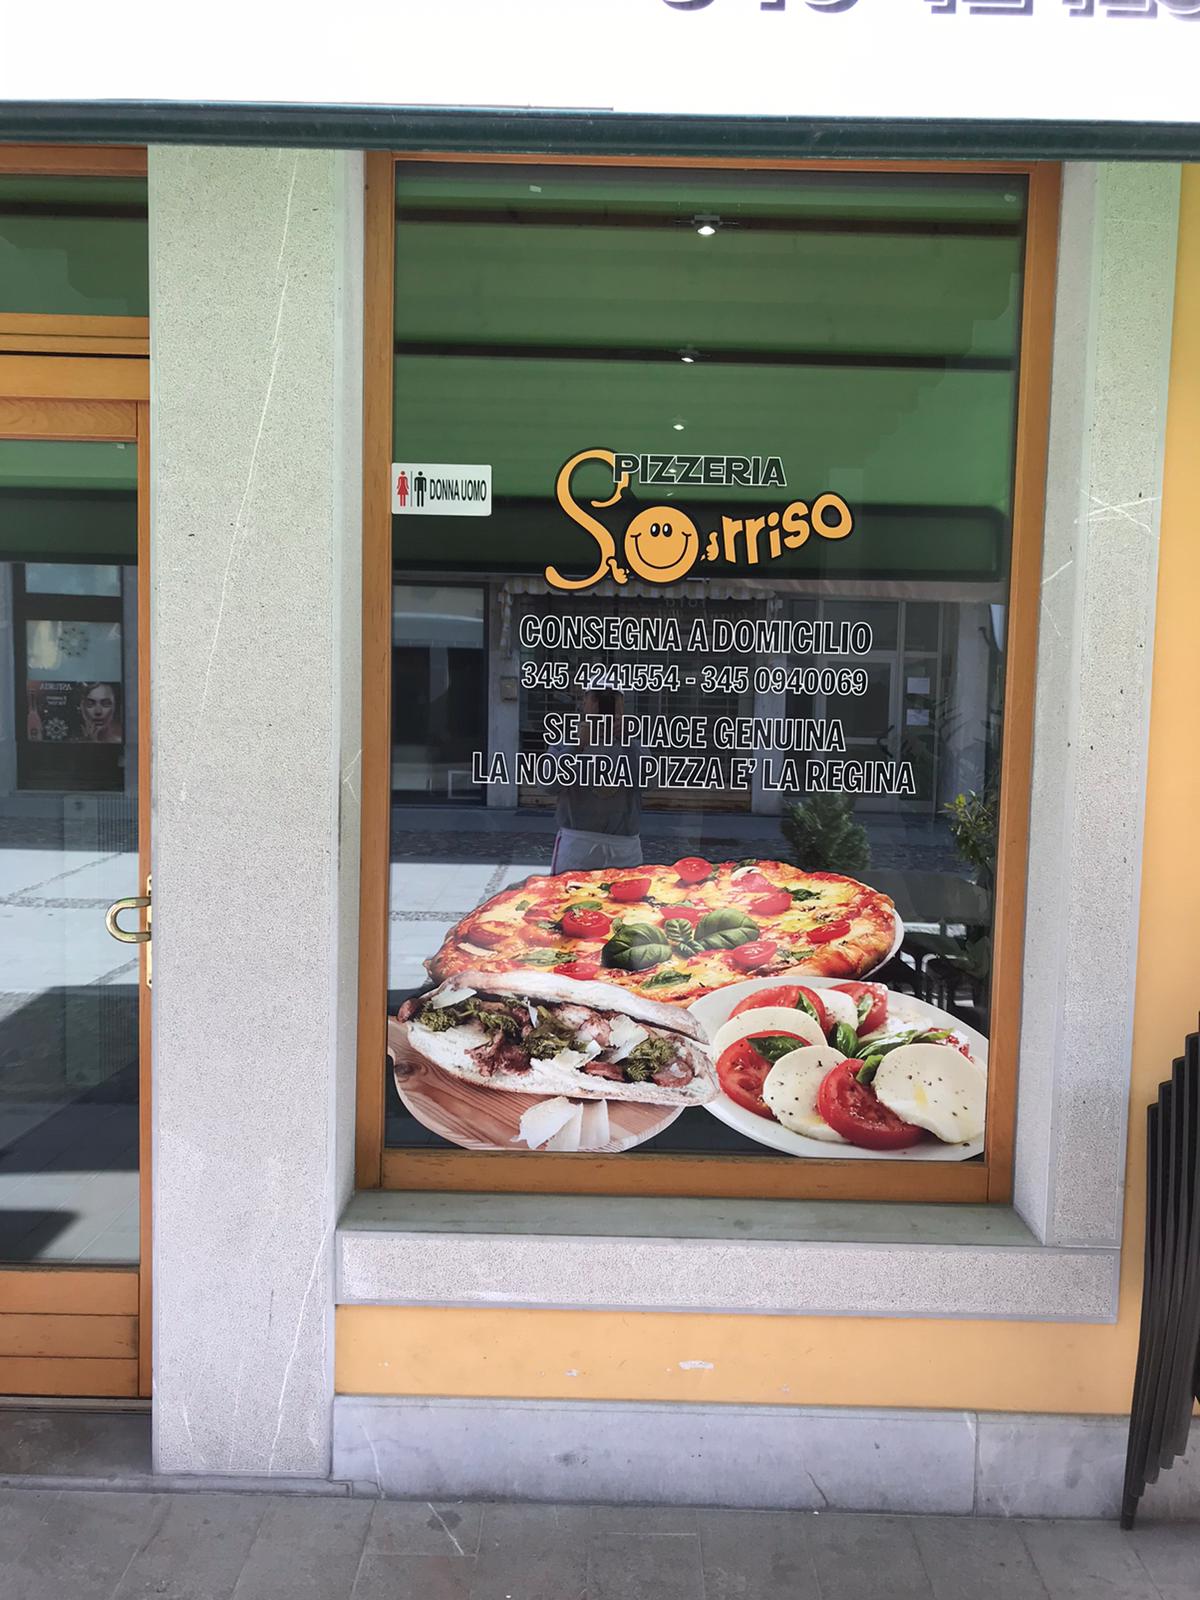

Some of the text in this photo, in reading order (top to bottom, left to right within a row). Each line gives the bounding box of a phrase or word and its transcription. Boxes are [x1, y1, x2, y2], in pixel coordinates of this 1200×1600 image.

[613, 453, 787, 487] PIZZERIA
[429, 478, 487, 502] DONNA UOMO
[519, 614, 873, 655] CONSEGNA A DOMICILIO
[521, 661, 868, 696] 345 4241554 - 345 0940069
[543, 712, 846, 752] SE TI PIACE GENUINA
[472, 751, 509, 785] LA
[514, 752, 633, 788] NOSTRA
[638, 755, 725, 790] PIZZA
[762, 758, 800, 792] LA
[805, 759, 916, 795] REGINA
